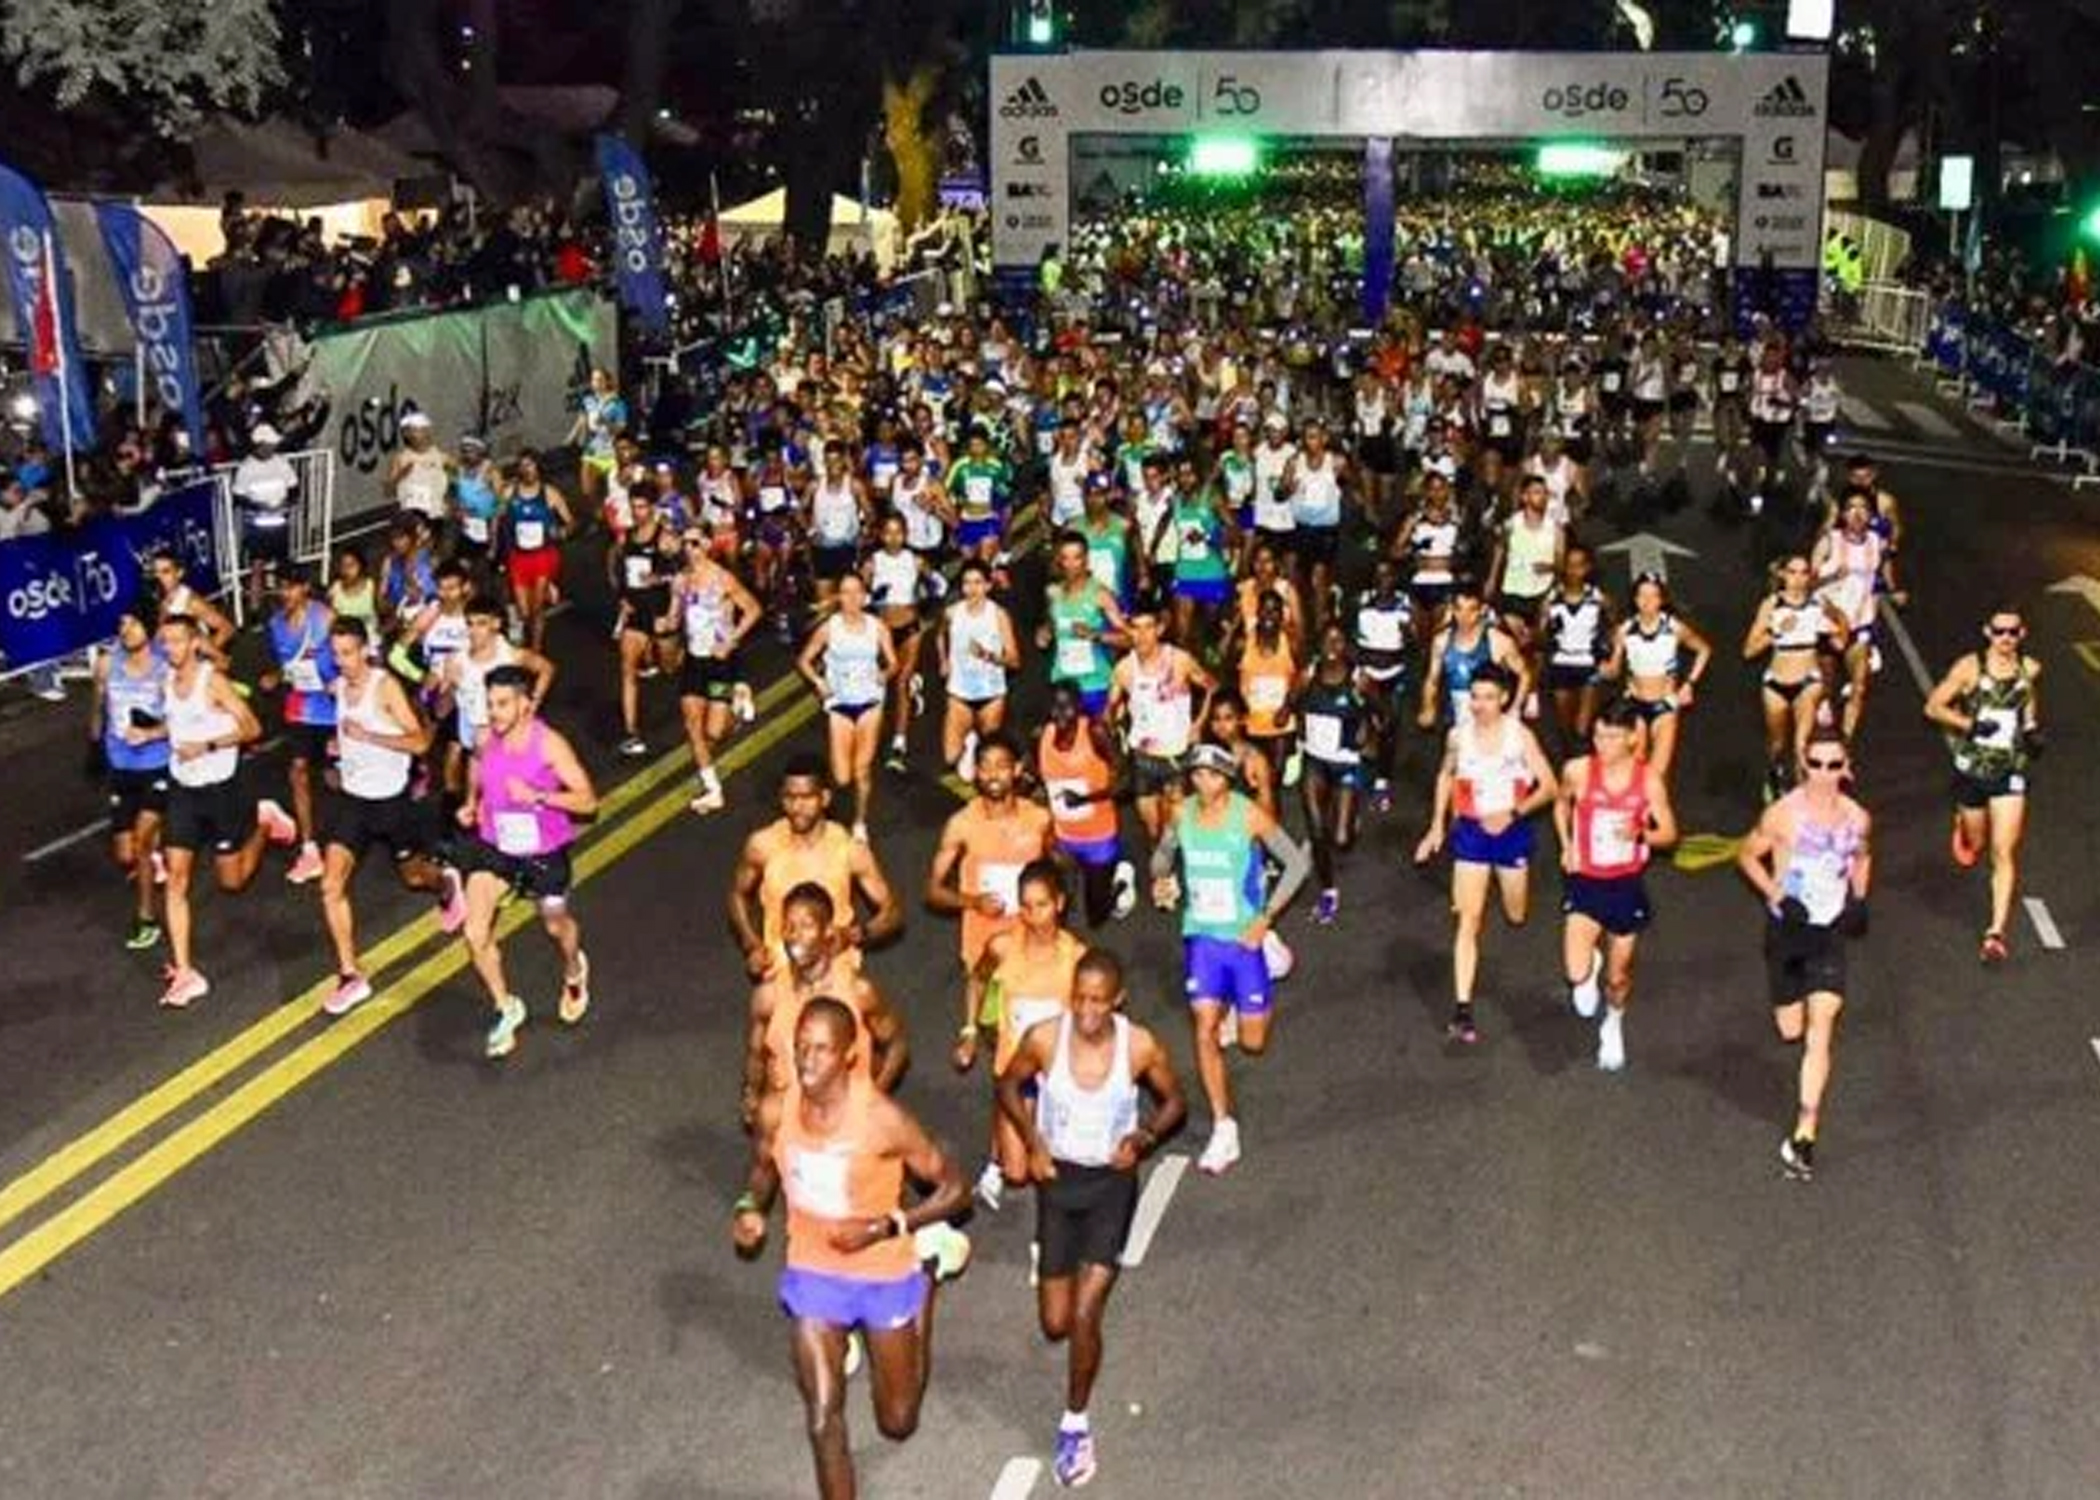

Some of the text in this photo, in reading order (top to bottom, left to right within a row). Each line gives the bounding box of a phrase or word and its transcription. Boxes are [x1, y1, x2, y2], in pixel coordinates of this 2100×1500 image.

[1100, 76, 1261, 116] osde 50
[1542, 78, 1711, 117] osde 50
[1773, 136, 1794, 159] G
